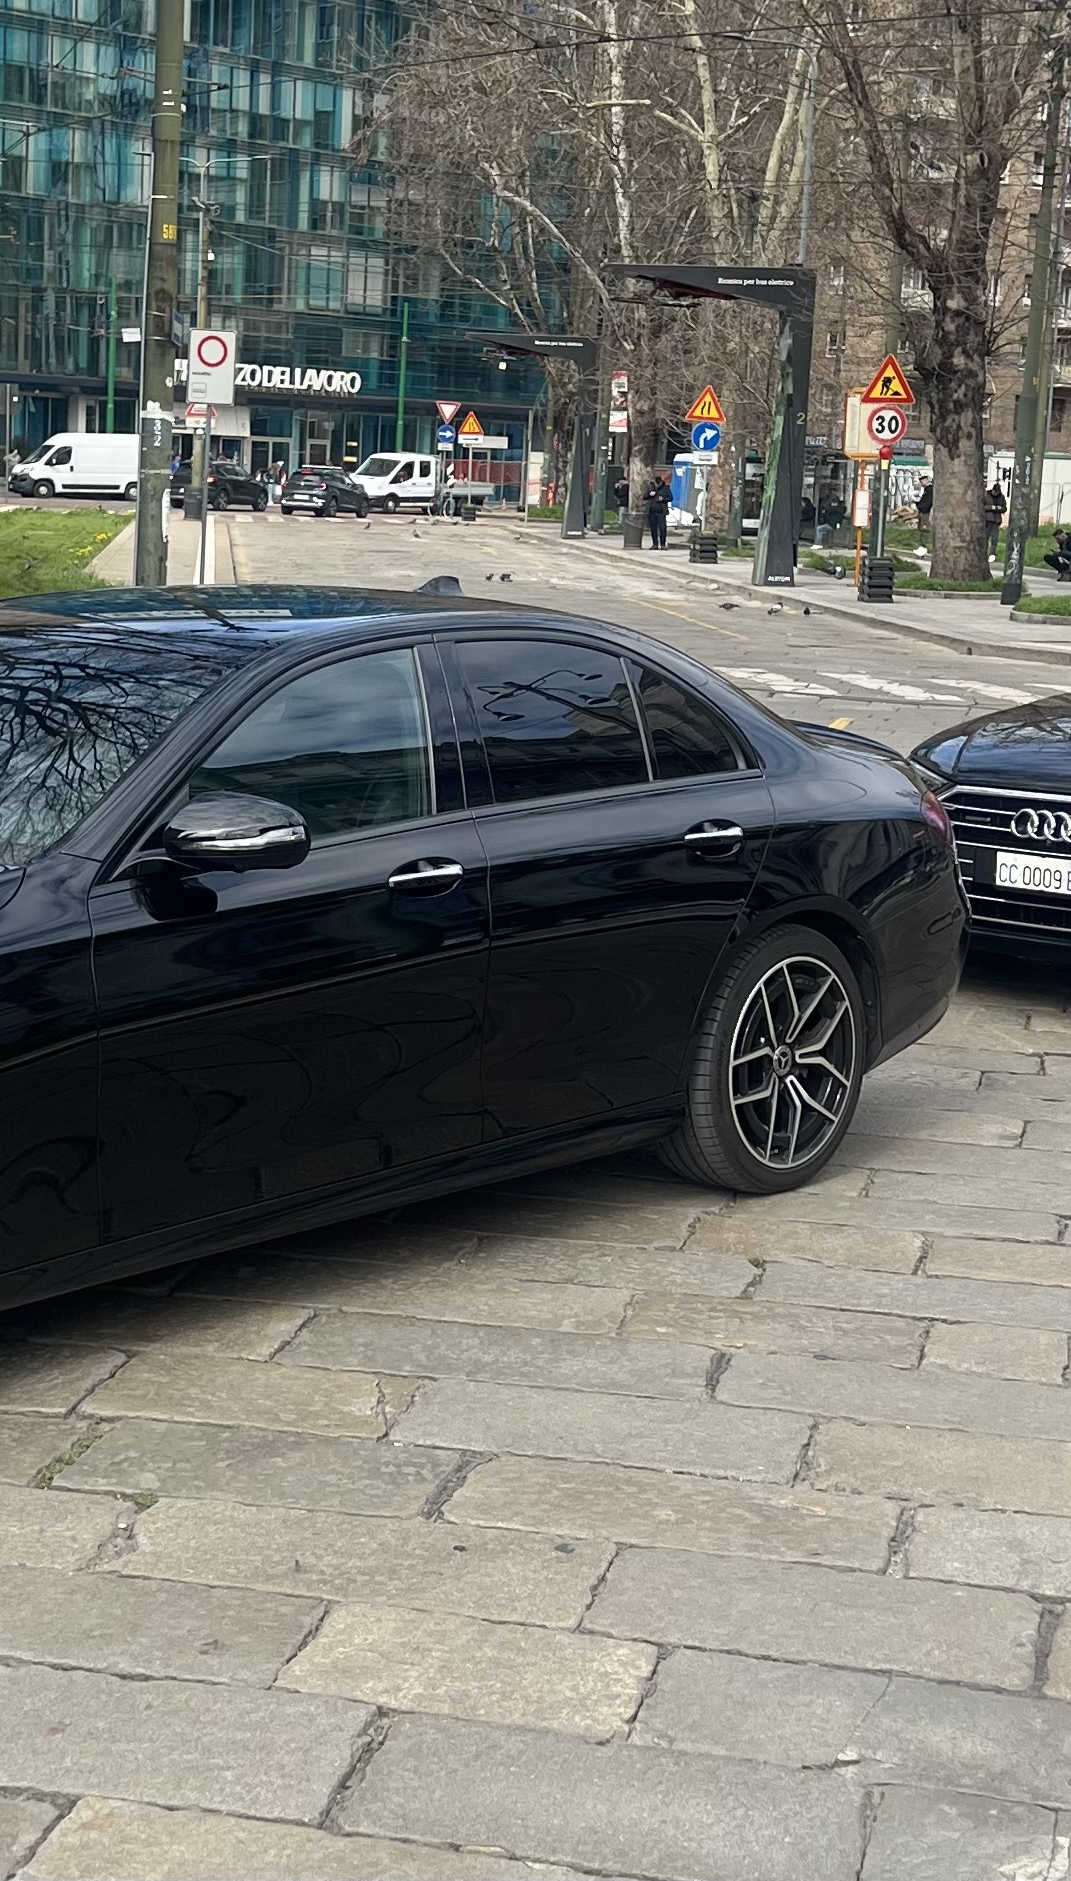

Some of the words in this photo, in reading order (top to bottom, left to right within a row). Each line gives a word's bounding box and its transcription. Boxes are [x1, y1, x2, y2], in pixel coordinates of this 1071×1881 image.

[875, 414, 900, 435] 30
[999, 863, 1018, 884] CC
[1023, 866, 1062, 889] 0009
